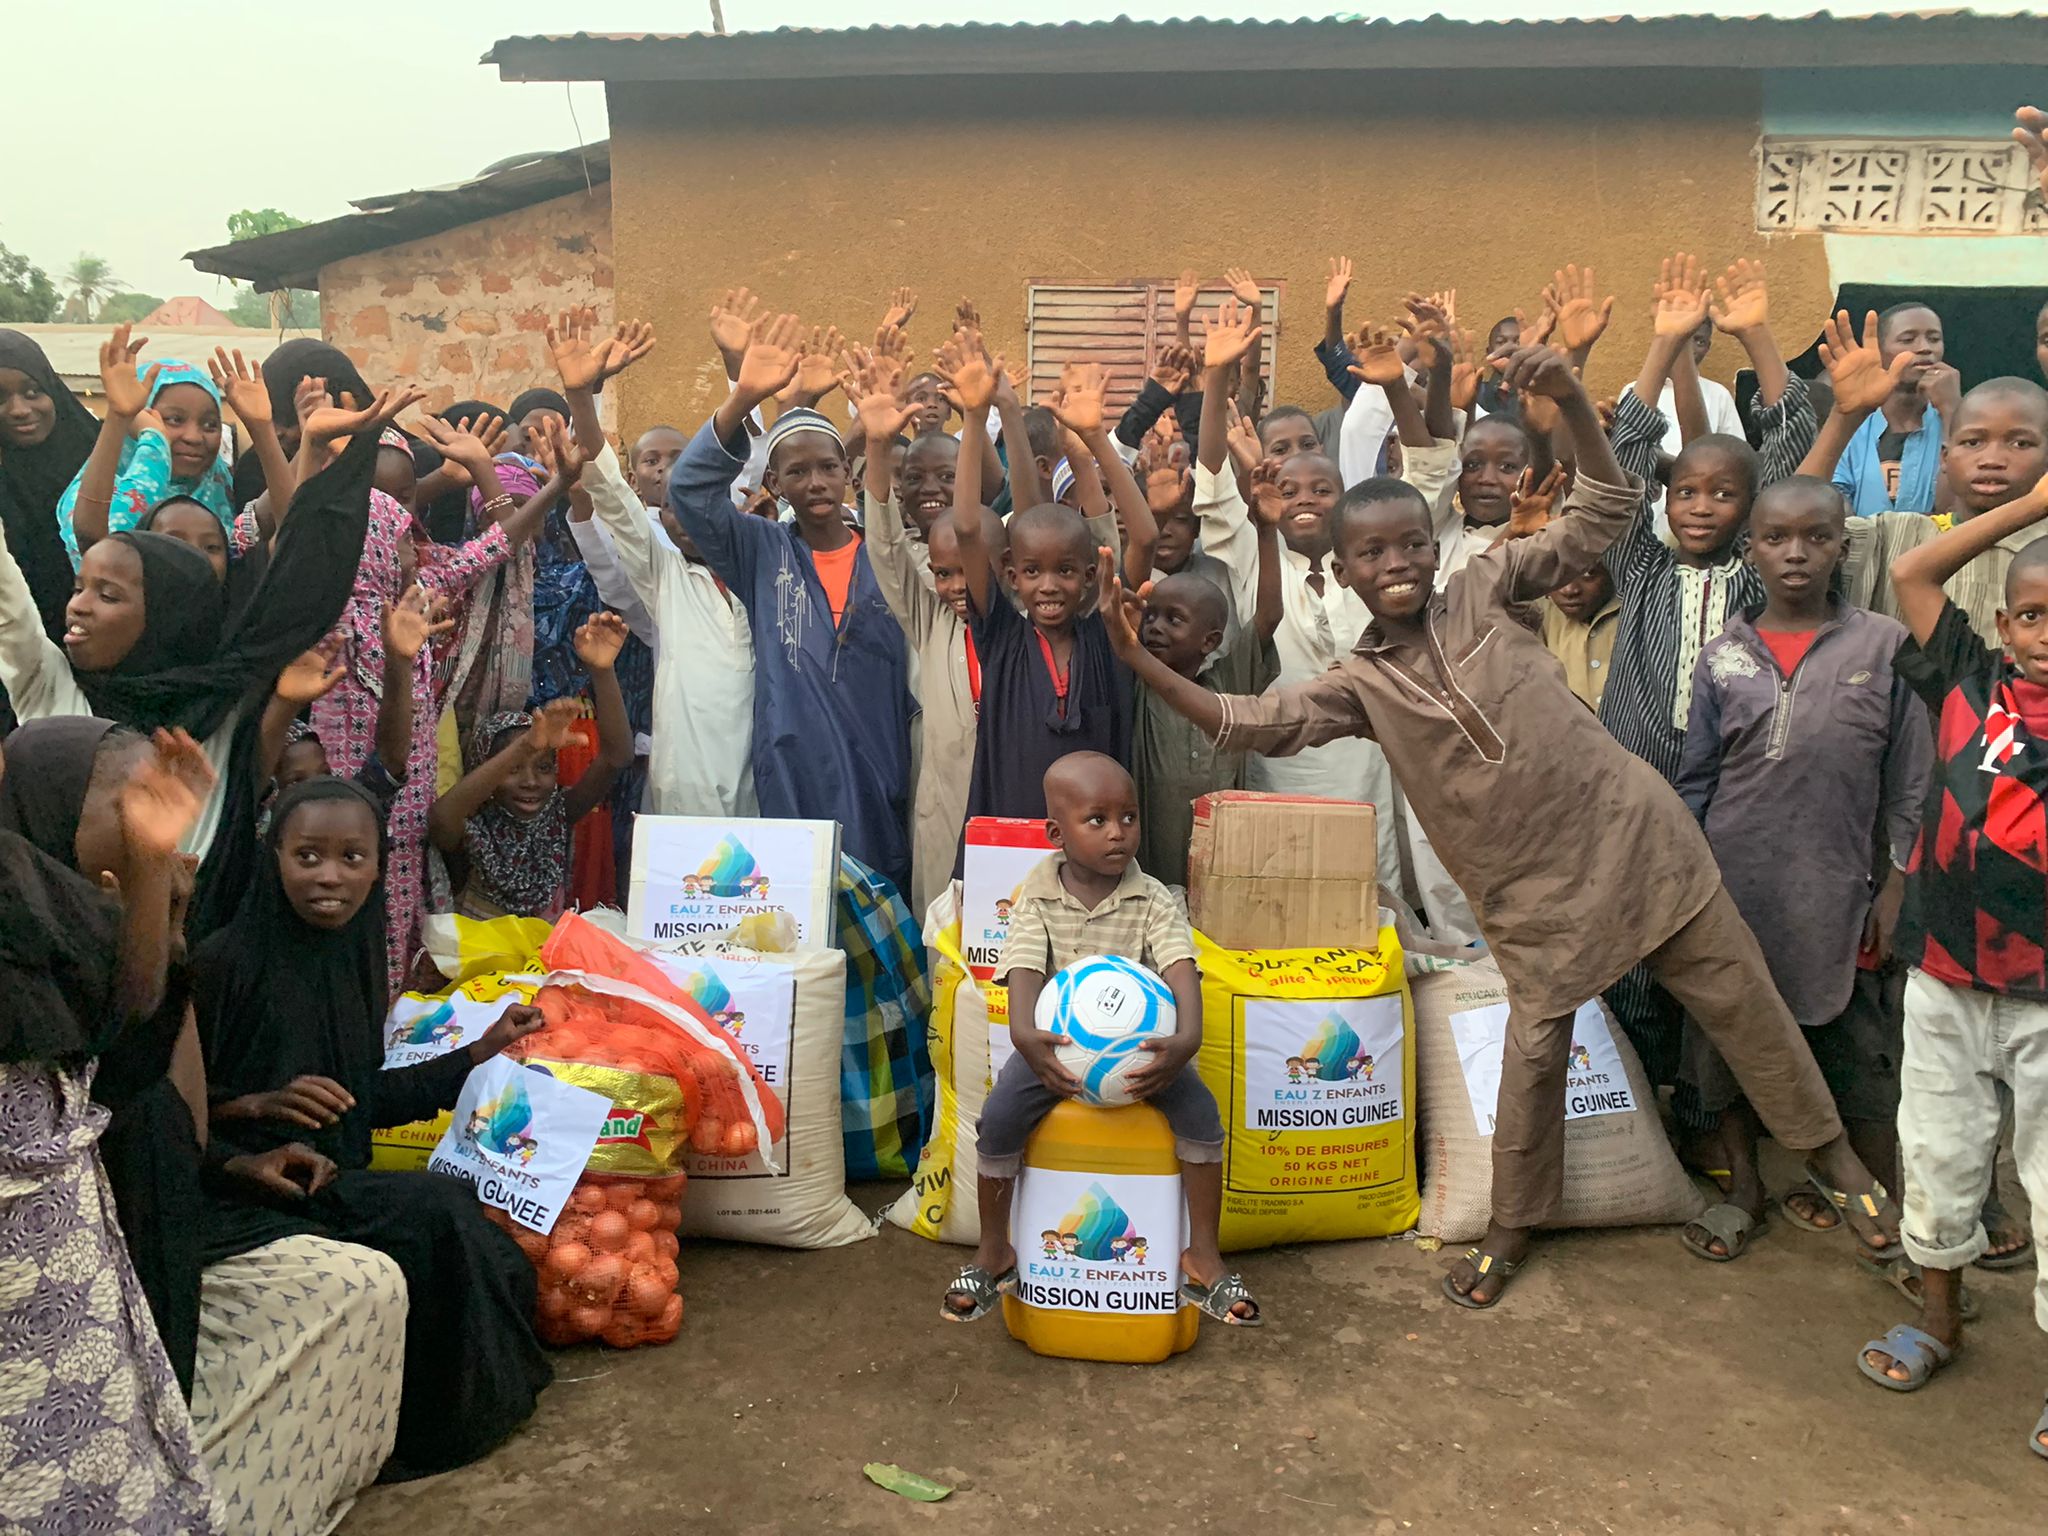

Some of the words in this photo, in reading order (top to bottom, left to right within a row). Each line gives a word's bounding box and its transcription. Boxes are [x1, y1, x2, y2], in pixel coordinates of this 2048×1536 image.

[670, 904, 700, 914] EAU
[406, 1051, 440, 1061] ENFA
[1566, 1073, 1610, 1088] FANTS
[1274, 1089, 1307, 1100] EAU
[1326, 1084, 1386, 1100] ENFANTS
[1571, 1091, 1631, 1114] GUINEE
[1257, 1108, 1337, 1127] MISSION
[1342, 1100, 1399, 1125] GUINEE
[600, 1116, 642, 1137] and
[1259, 1145, 1290, 1156] 10%
[1295, 1146, 1316, 1156] DE
[1321, 1138, 1389, 1155] BRISURES
[697, 1159, 748, 1171] CHINA
[1284, 1161, 1300, 1172] 50
[1306, 1161, 1338, 1171] KGS
[1343, 1157, 1370, 1169] NET
[1270, 1175, 1333, 1187] ORIGINE
[1339, 1170, 1380, 1184] CHINE
[484, 1179, 550, 1227] GUNEE
[1029, 1262, 1064, 1277] EAU
[1086, 1269, 1167, 1281] ENFANTS
[1017, 1281, 1100, 1309] MISSION
